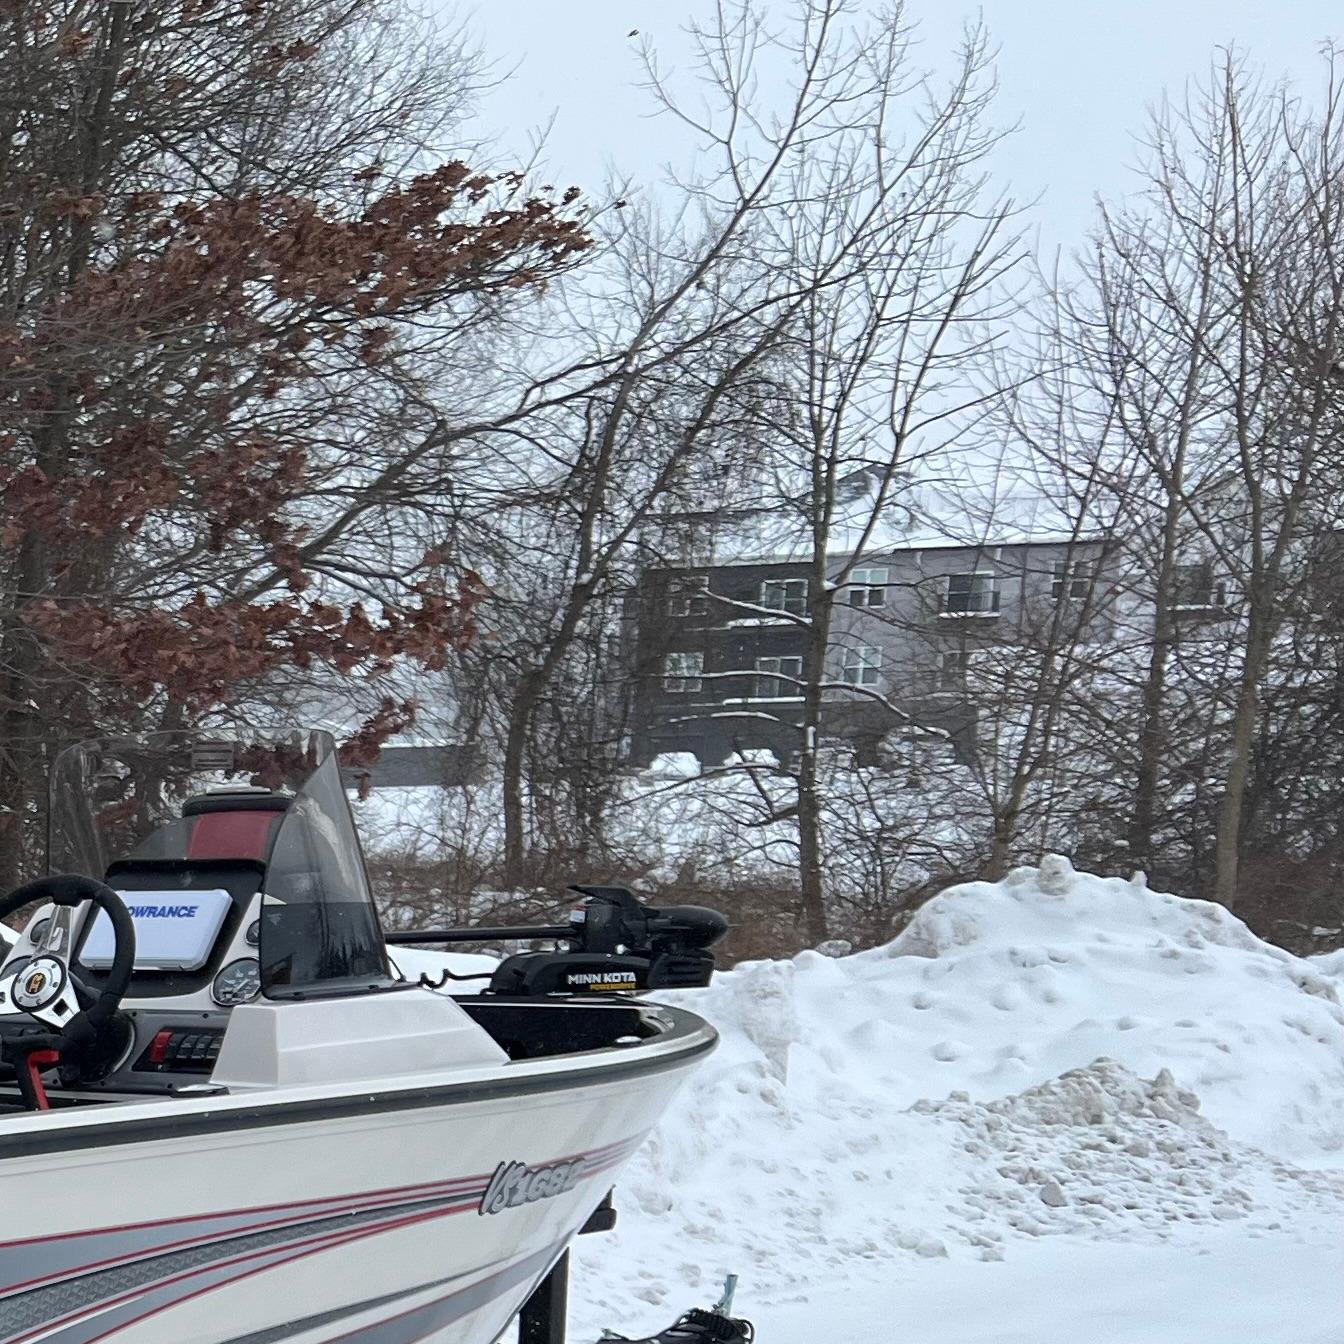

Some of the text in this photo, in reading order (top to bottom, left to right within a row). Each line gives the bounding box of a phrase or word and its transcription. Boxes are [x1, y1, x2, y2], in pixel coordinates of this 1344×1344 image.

[127, 905, 199, 919] OWRANCE
[567, 971, 637, 985] MINN KOTA
